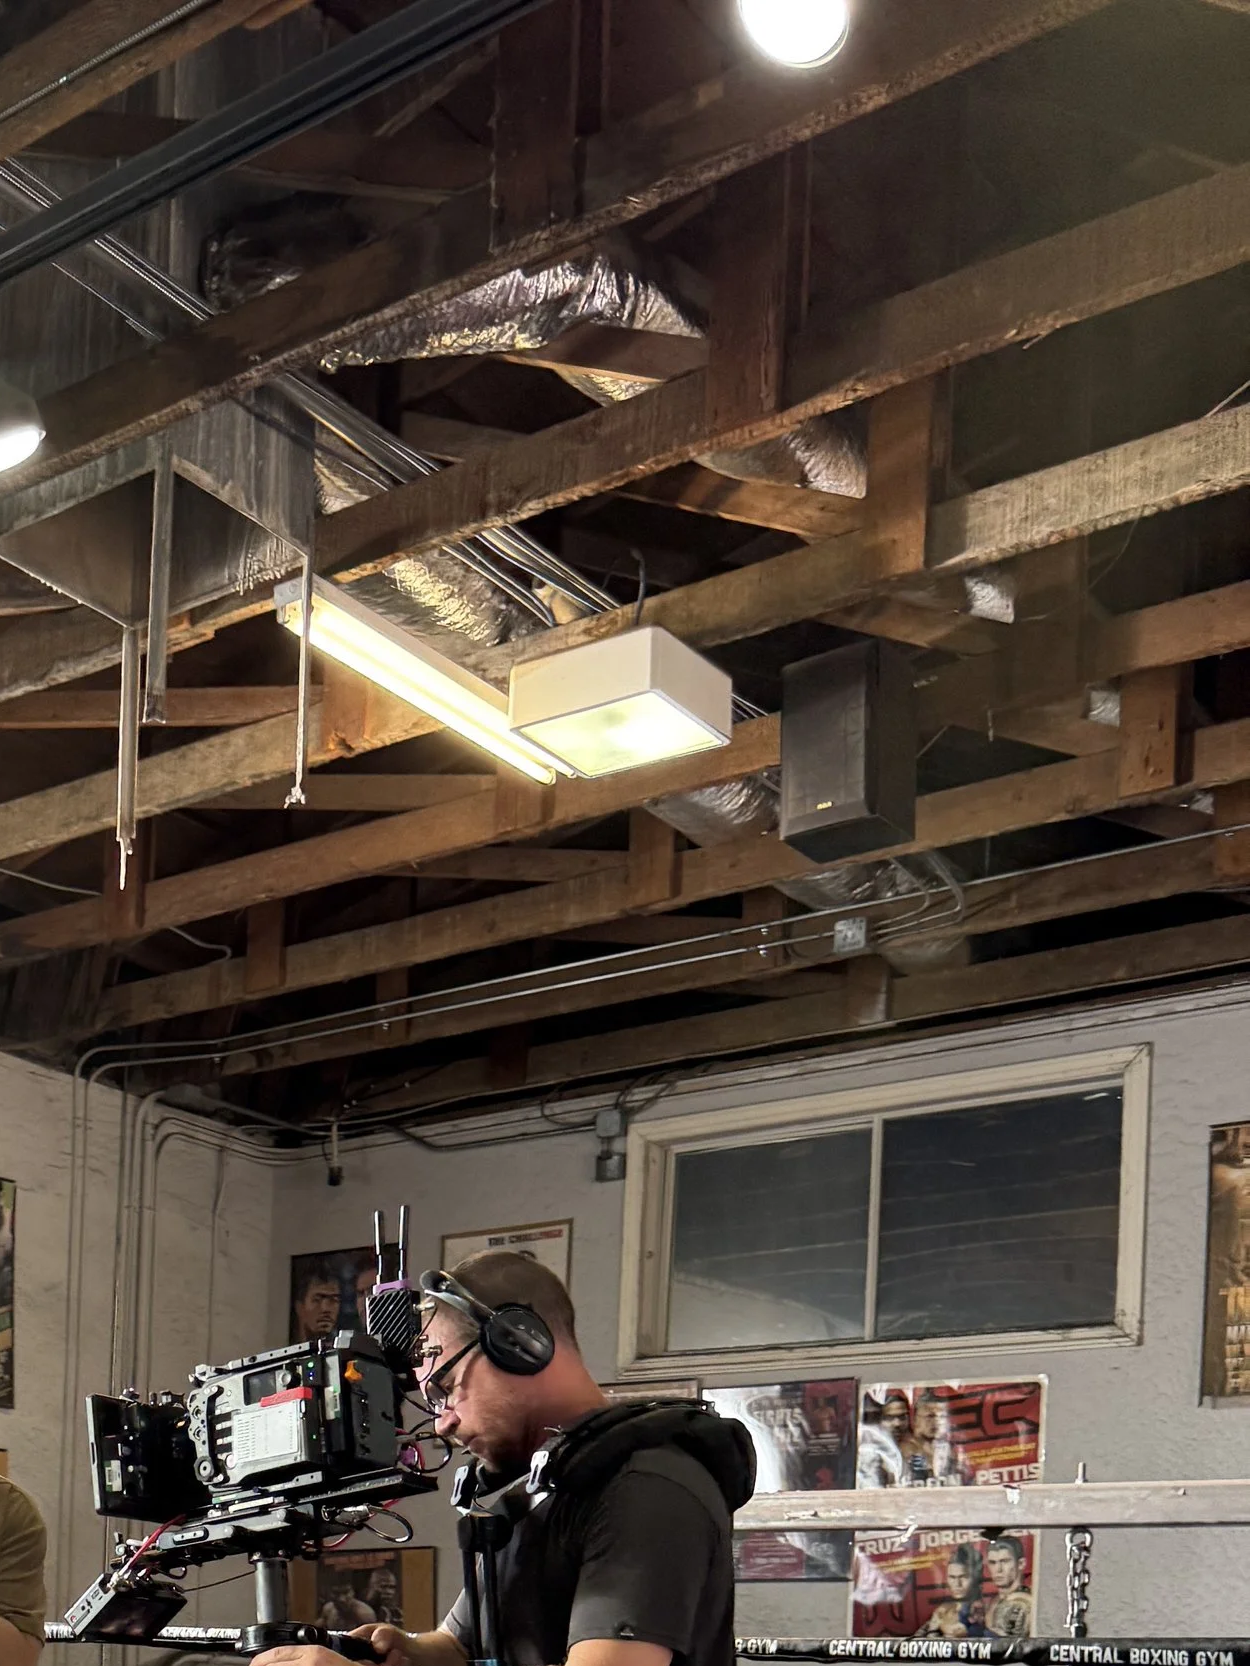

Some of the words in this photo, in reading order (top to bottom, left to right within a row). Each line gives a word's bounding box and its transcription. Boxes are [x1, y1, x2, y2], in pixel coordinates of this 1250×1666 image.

[976, 1463, 1040, 1485] PETTIS
[747, 1639, 777, 1654] GYM
[829, 1640, 893, 1657] CENTRAL
[900, 1641, 951, 1658] BOXING
[958, 1643, 991, 1660] GYM
[1050, 1645, 1124, 1664] CENTRAL
[1130, 1648, 1188, 1666] BOXING
[1195, 1651, 1234, 1666] GYM
